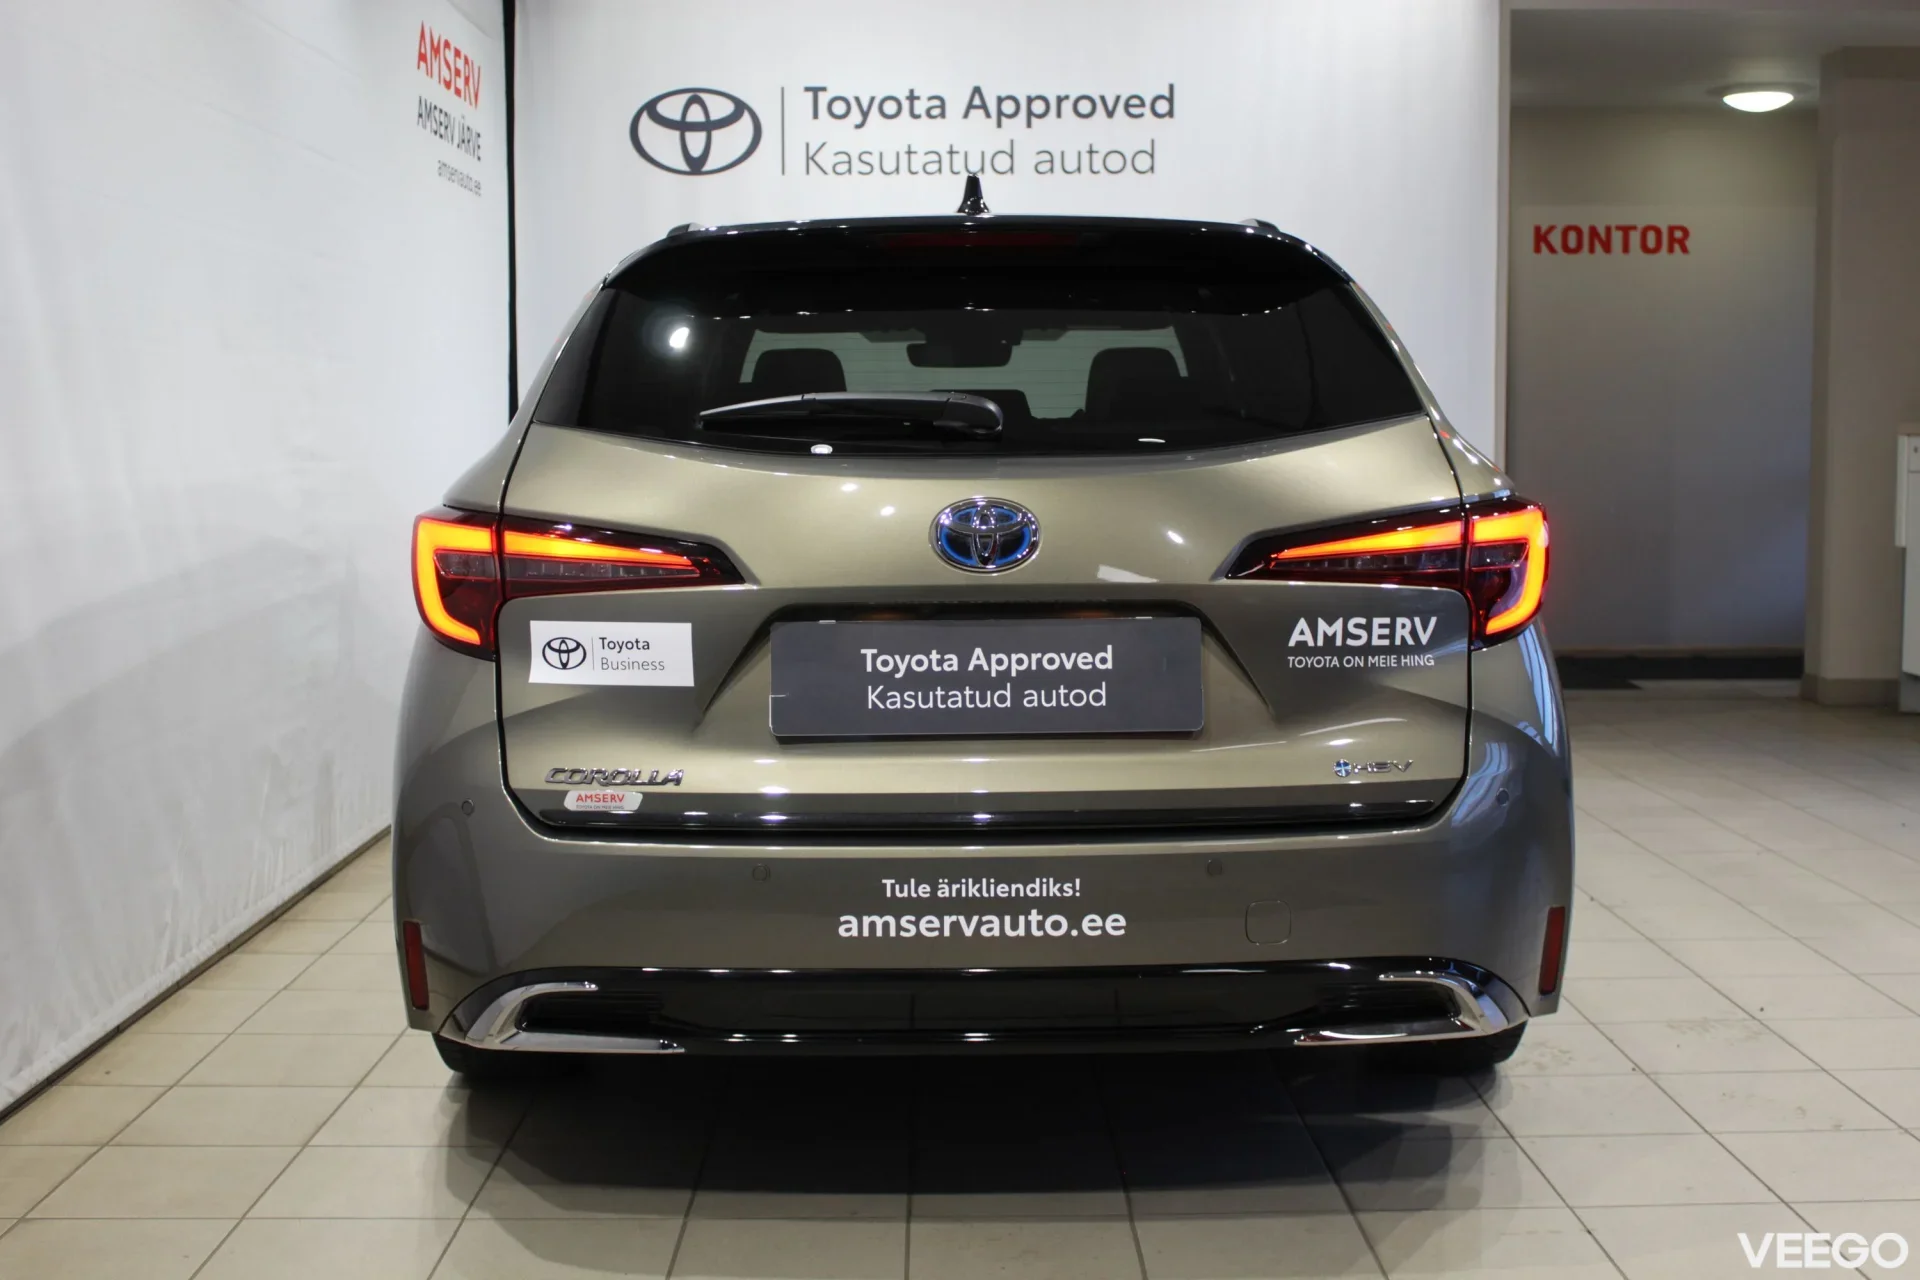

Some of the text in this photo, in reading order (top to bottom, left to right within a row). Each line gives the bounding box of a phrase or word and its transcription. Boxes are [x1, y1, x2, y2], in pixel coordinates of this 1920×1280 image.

[417, 20, 481, 109] AMSERV
[804, 83, 1175, 128] Toyota Approved
[417, 96, 481, 161] AMSERV JÄRVE
[805, 138, 1156, 175] Kasutatud autod
[1533, 224, 1690, 255] KONTOR
[599, 637, 650, 653] Toyota
[1288, 616, 1437, 647] AMSERV
[601, 657, 665, 671] Business
[861, 645, 1113, 678] Toyota Approved
[1288, 654, 1435, 668] TOYOTA ON MEIE HING
[868, 682, 1106, 709] Kasutatud autod
[544, 767, 684, 787] COROLLA
[576, 793, 625, 803] AMSERV
[882, 878, 1080, 897] Tule ärikliendiks!
[838, 908, 1126, 937] amservauto.ee
